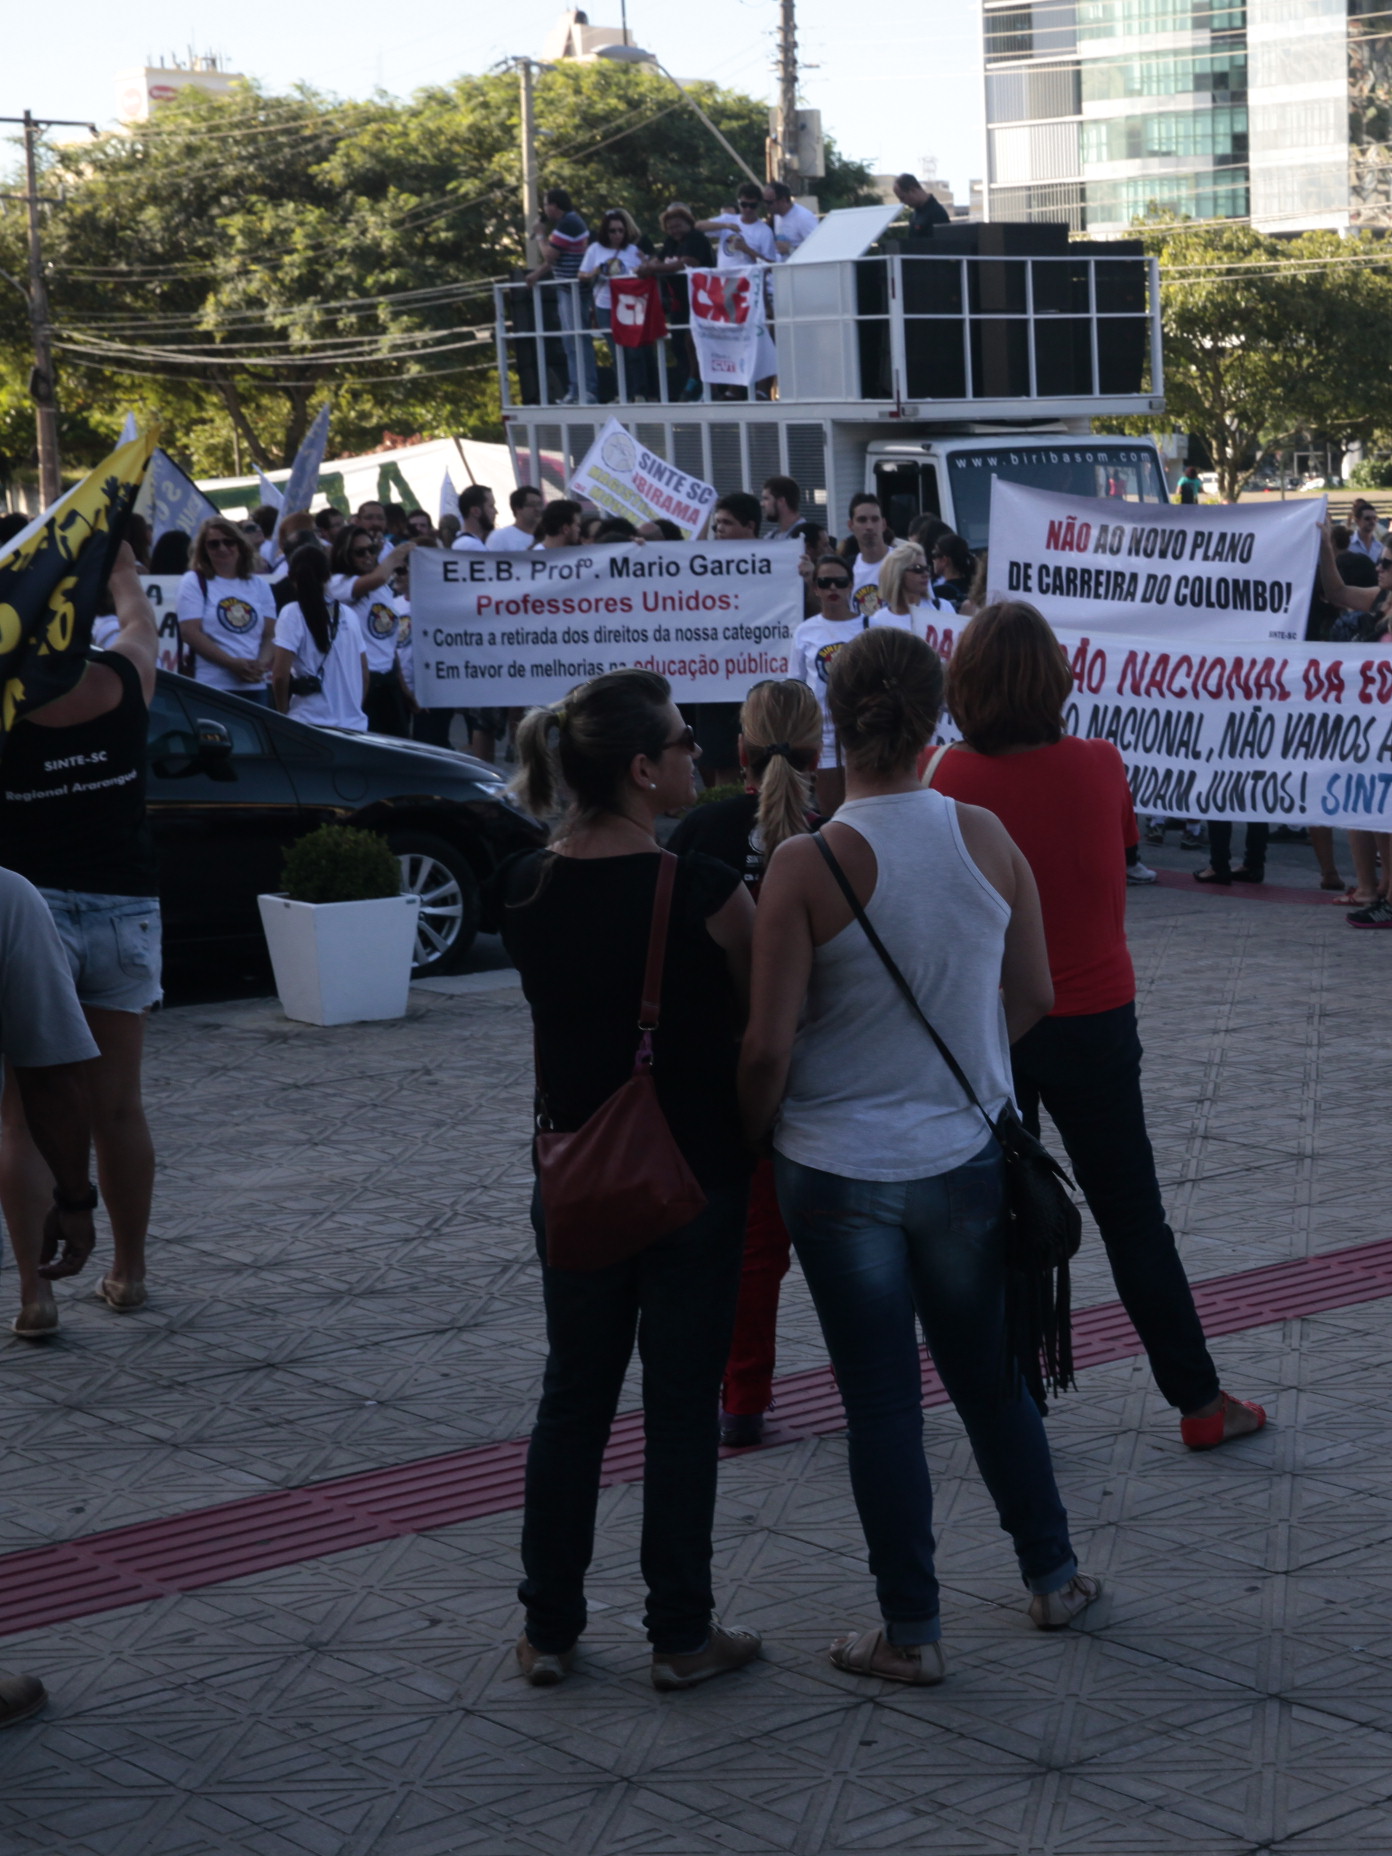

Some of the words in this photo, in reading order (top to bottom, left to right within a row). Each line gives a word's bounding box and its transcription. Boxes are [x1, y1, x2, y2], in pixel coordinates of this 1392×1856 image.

[638, 452, 687, 493] SINTE
[686, 482, 713, 504] SC
[1045, 515, 1092, 553] NÃO
[1093, 524, 1125, 556] AO
[1127, 527, 1187, 560] NOVO
[1189, 530, 1255, 564] PLANO
[443, 560, 521, 582] E.E.B.
[609, 556, 680, 578] Mario
[689, 553, 772, 577] Garcia
[476, 594, 633, 616] Professores
[642, 590, 739, 612] Unidos:
[1008, 560, 1032, 593] DE
[1037, 563, 1138, 602] CARREIRA
[1140, 573, 1172, 605] DO
[1174, 574, 1292, 614] COLOMBO!
[433, 628, 483, 647] Contra
[488, 633, 496, 646] a
[501, 627, 558, 646] retirada
[562, 626, 589, 645] dos
[594, 625, 648, 643] direitos
[653, 624, 671, 642] da
[675, 627, 718, 641] nossa
[722, 621, 793, 645] categoria.
[435, 660, 460, 679] Em
[465, 660, 502, 679] favor
[508, 660, 526, 678] de
[531, 658, 604, 677] melhorias
[725, 650, 788, 680] pública
[1117, 650, 1291, 701] NACIONAL
[1303, 658, 1345, 704] DA
[1218, 705, 1275, 760] NÃO
[1281, 712, 1377, 764] VAMOS
[44, 750, 108, 772] SINTE-SC
[5, 784, 69, 803] Regional
[1196, 770, 1307, 815] JUNTOS!
